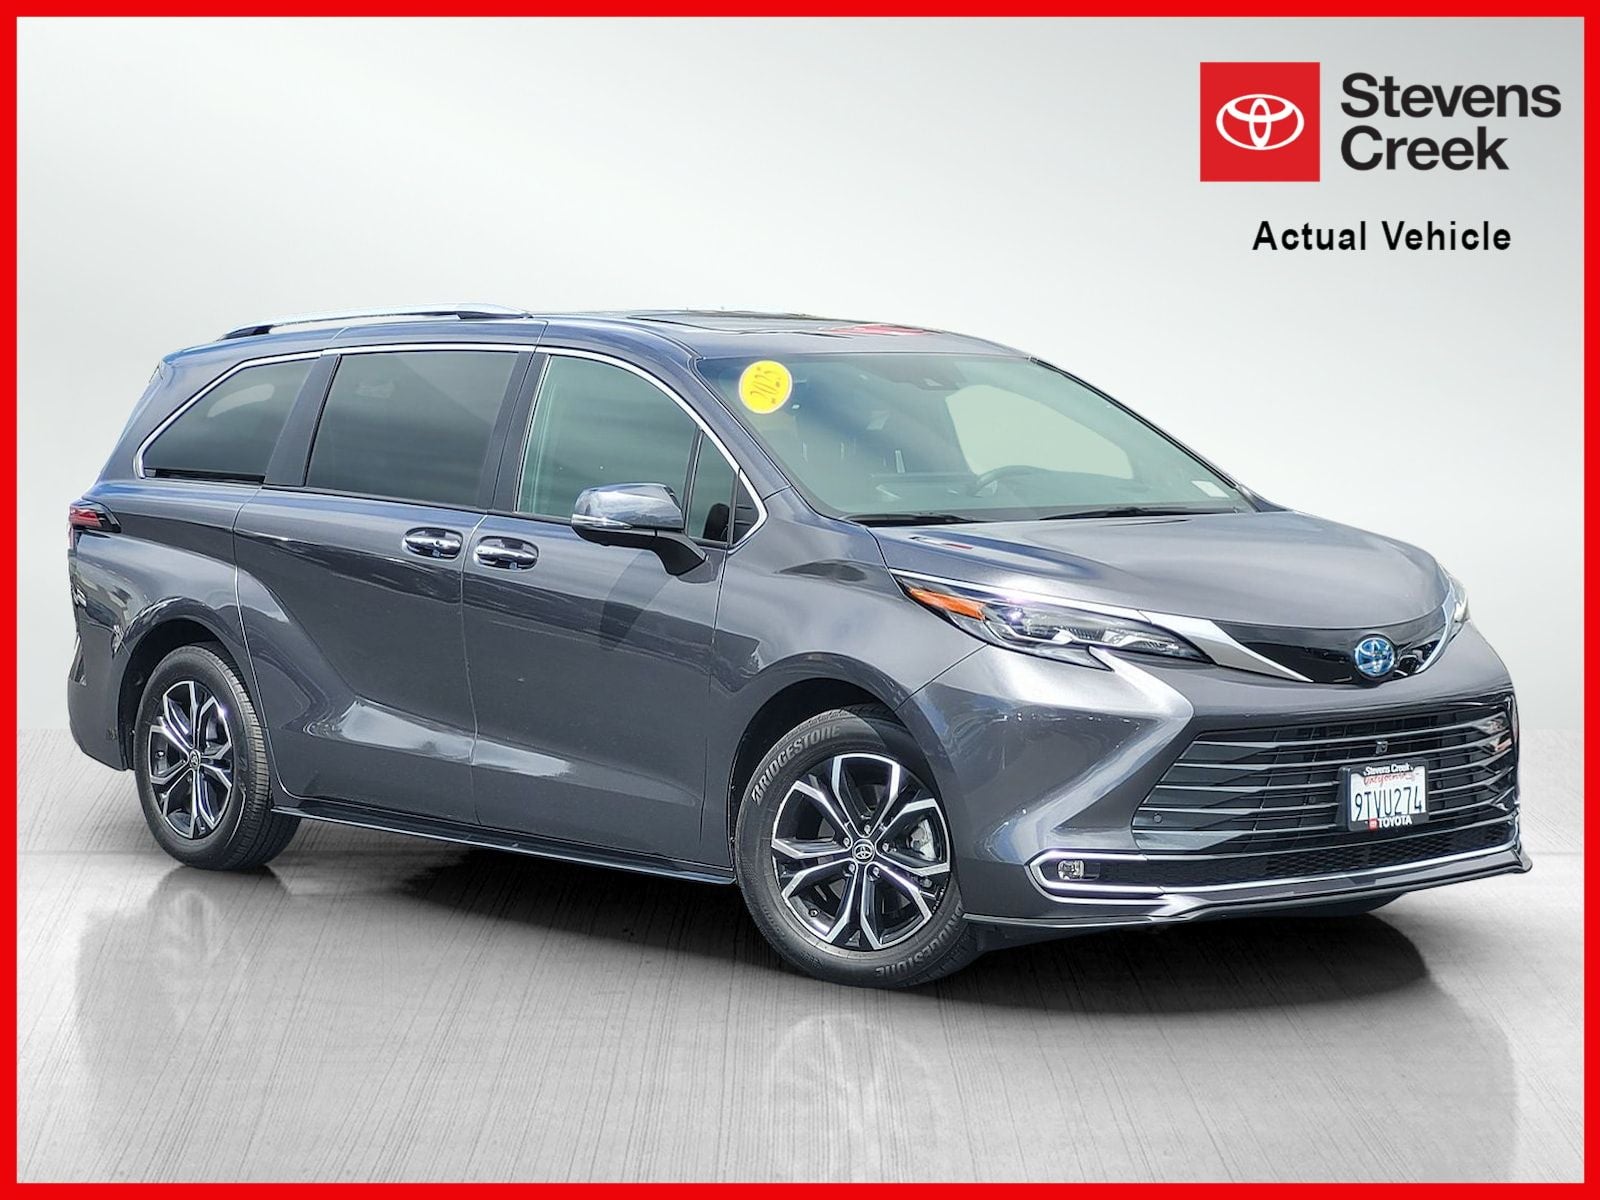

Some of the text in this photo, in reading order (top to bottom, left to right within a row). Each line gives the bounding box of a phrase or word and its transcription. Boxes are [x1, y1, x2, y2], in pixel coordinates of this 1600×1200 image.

[751, 724, 841, 807] BRIDGESTONE
[1365, 762, 1411, 776] Stevens Creek
[1354, 785, 1423, 821] 9TVU274
[1377, 814, 1413, 828] TOYOTA
